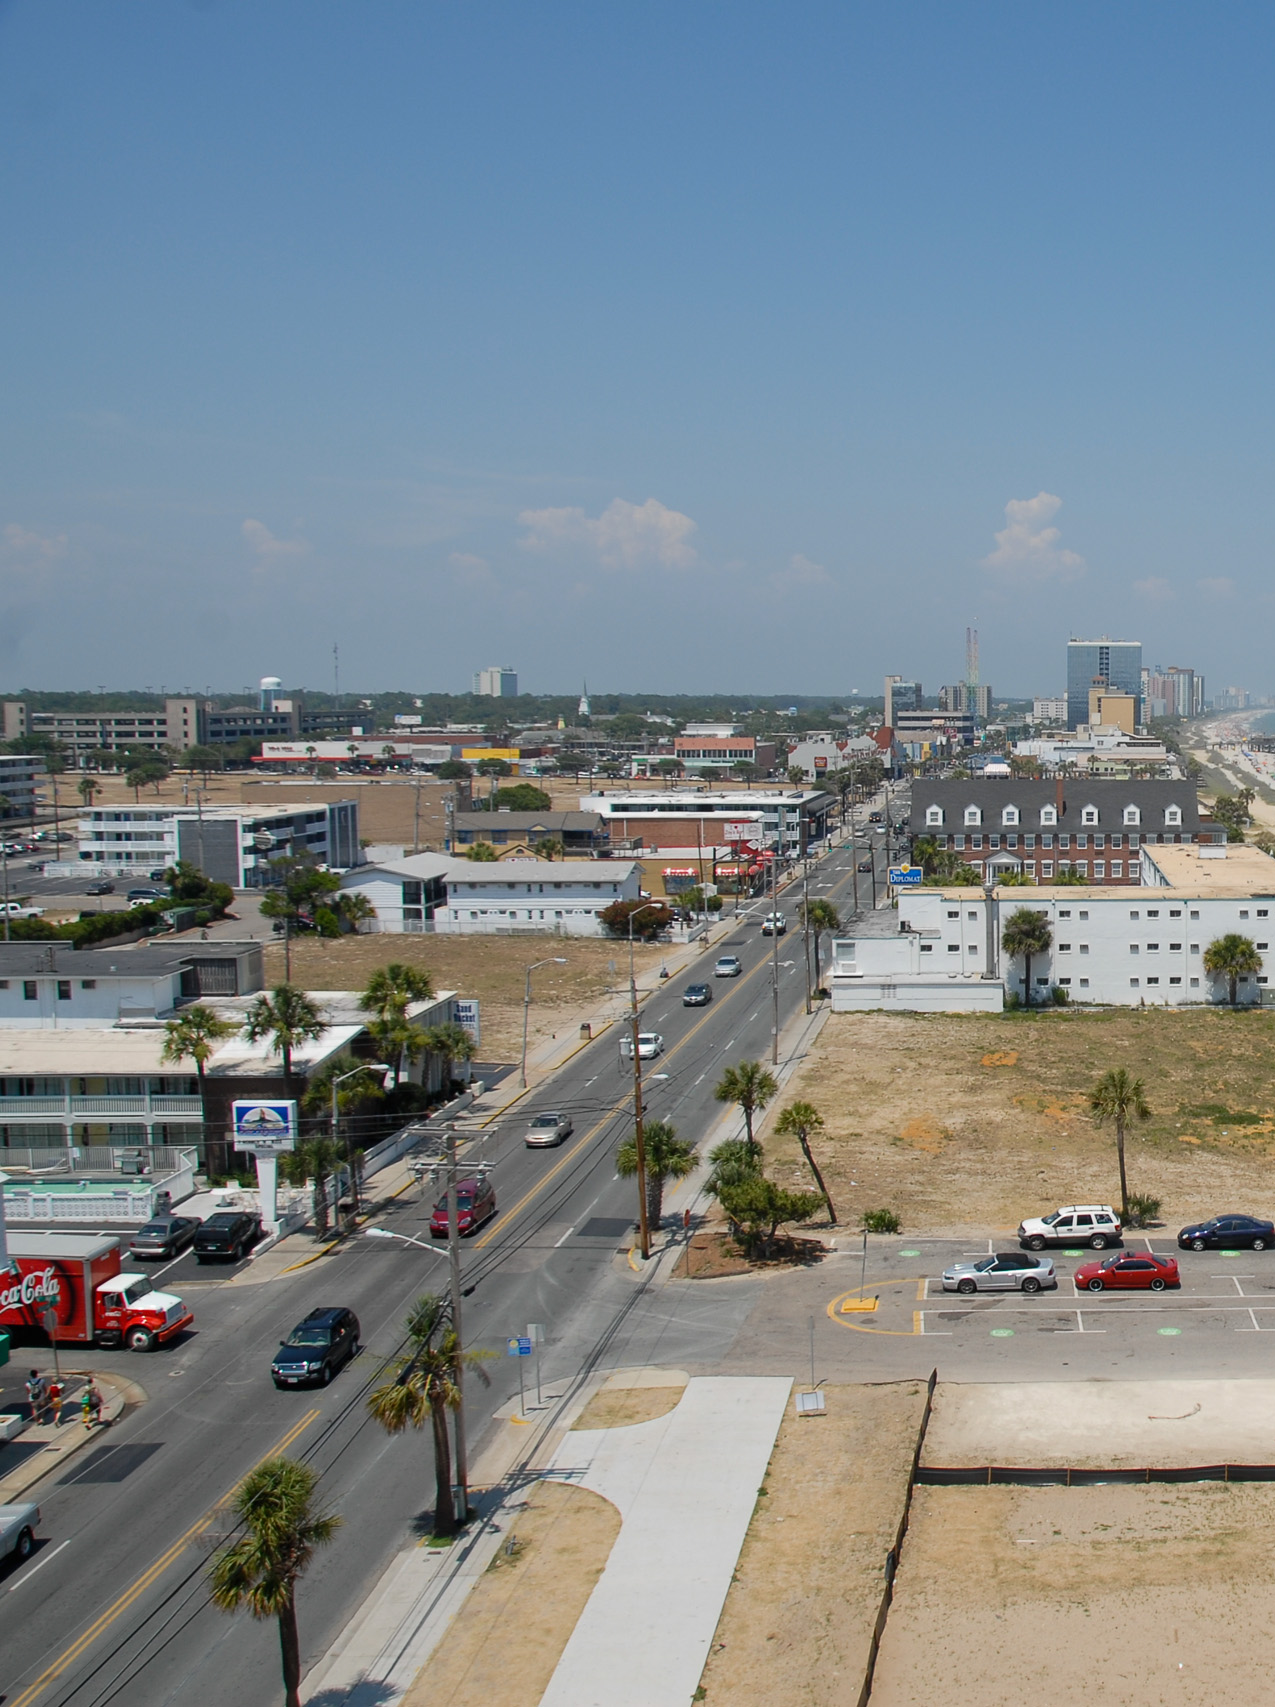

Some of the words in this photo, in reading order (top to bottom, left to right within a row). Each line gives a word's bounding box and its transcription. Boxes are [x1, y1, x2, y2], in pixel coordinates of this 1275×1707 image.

[890, 874, 921, 883] DIPLOMAT
[456, 1004, 472, 1012] Sand
[0, 1265, 61, 1306] ca-Cola
